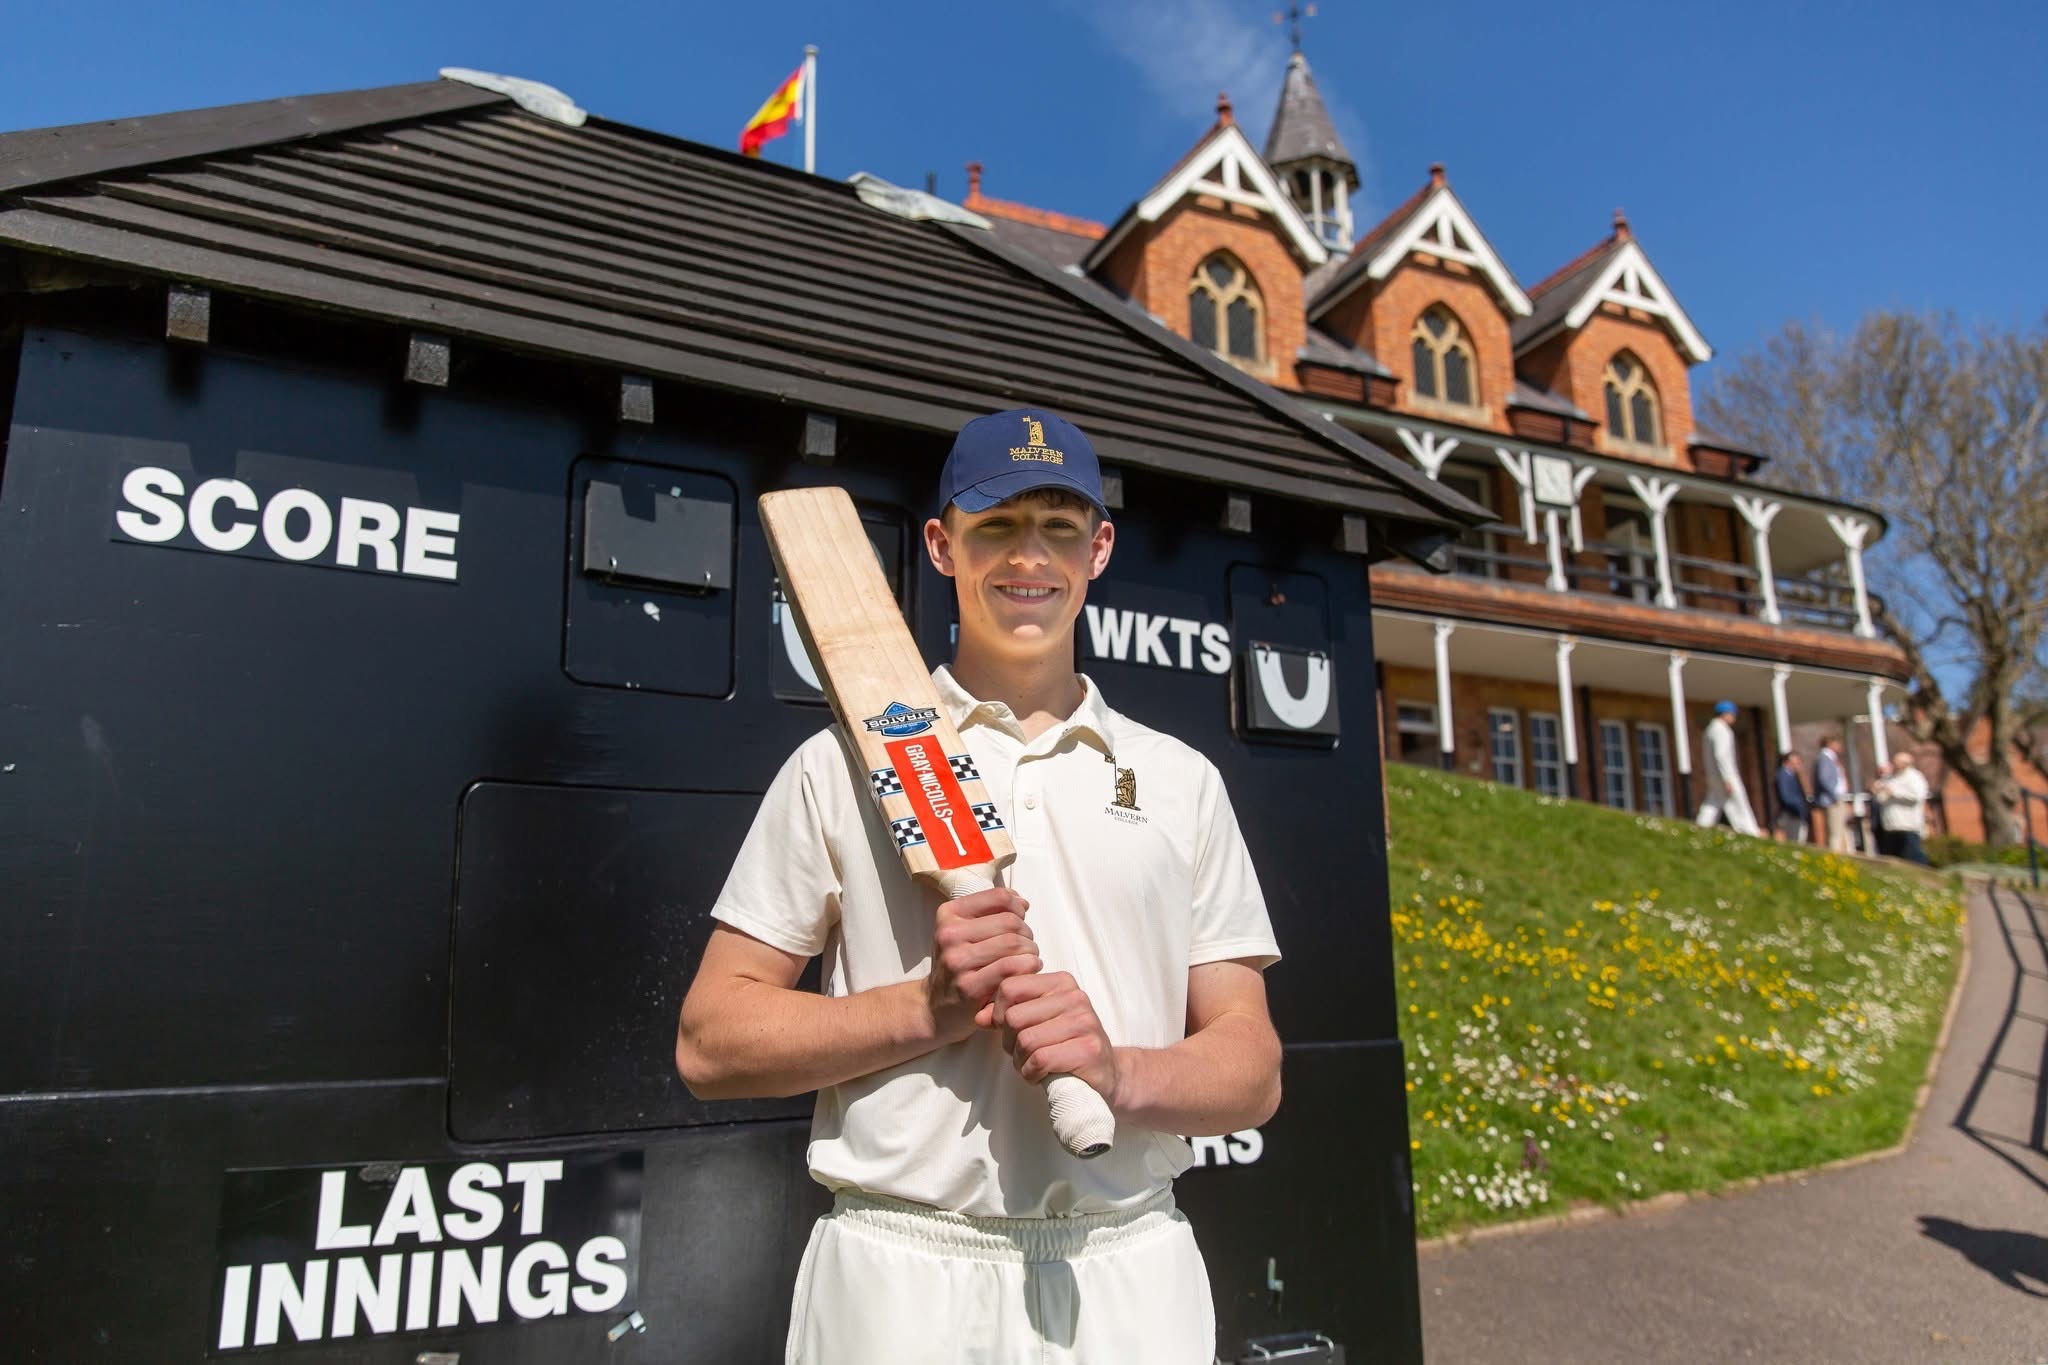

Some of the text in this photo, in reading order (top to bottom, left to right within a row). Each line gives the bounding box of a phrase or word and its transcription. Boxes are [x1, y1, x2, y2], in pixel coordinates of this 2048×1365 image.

[1009, 447, 1064, 458] MALVERN
[1012, 454, 1064, 465] COLLEGE
[116, 466, 460, 580] SCORE
[1085, 604, 1233, 675] WKTS
[869, 711, 935, 729] STRATOS
[1104, 806, 1149, 824] MALVERN
[1177, 1128, 1264, 1167] RS
[315, 1159, 563, 1251] LAST
[217, 1235, 628, 1350] INNINGS
